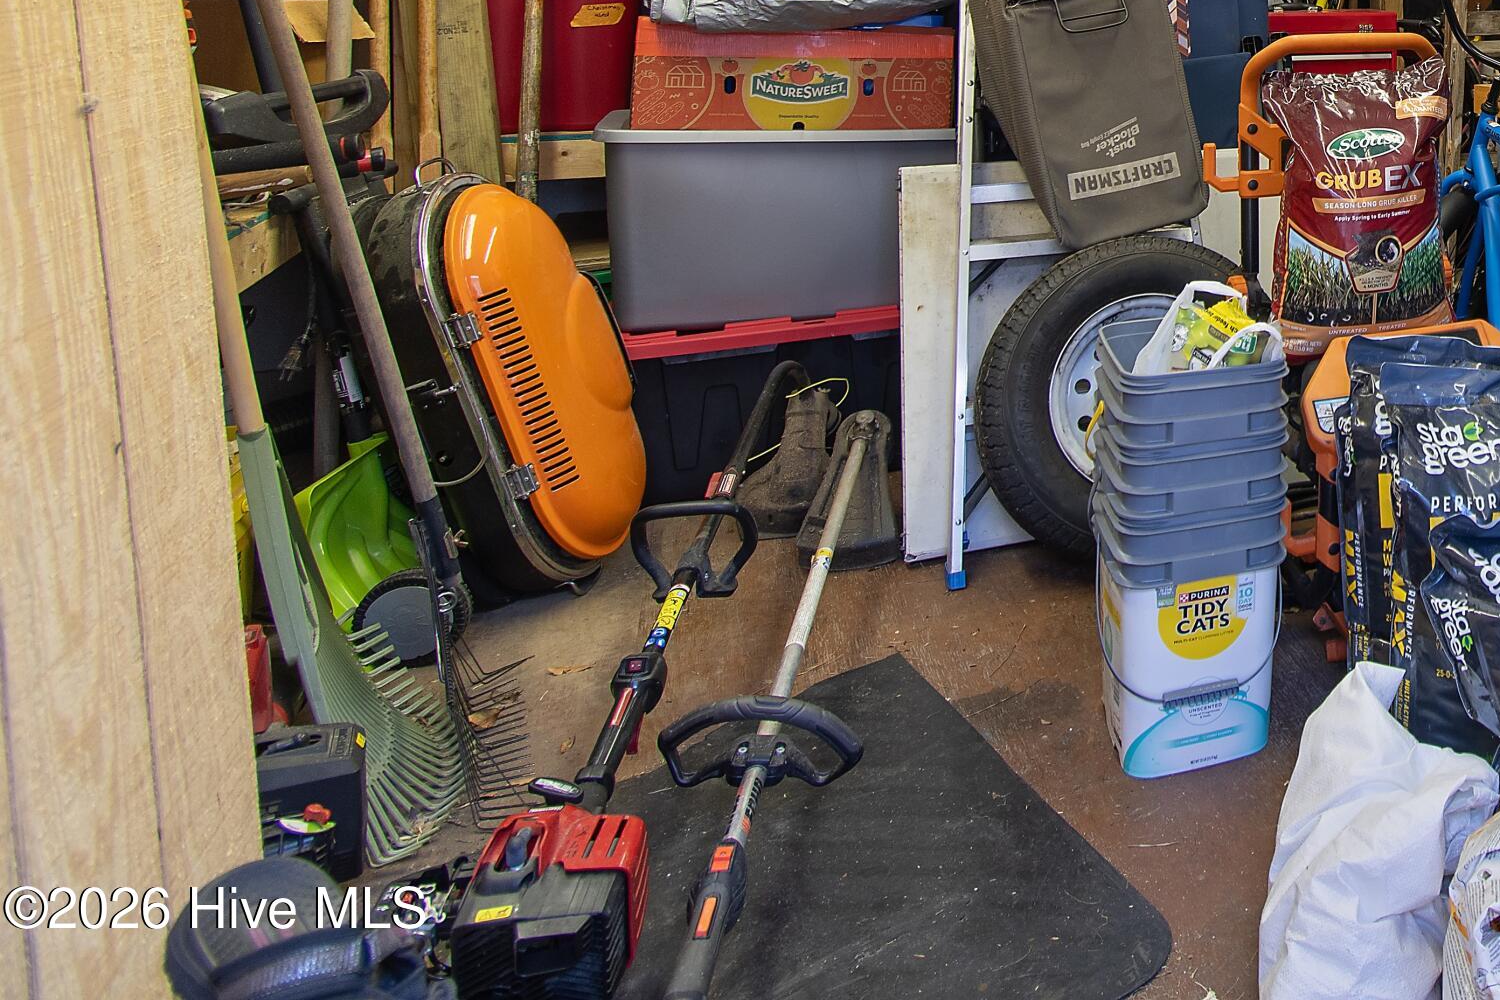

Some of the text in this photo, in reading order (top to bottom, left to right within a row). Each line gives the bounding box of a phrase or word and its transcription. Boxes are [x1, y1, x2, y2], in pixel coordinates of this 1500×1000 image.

[1080, 141, 1091, 149] Bag
[1095, 124, 1141, 153] Blocker
[1105, 137, 1137, 158] Dust-
[1074, 159, 1175, 194] CRAFTSMAN
[1324, 202, 1355, 210] SEASON
[1357, 200, 1377, 209] LONG
[1334, 209, 1411, 223] Apply Spring to Early Summer
[1367, 281, 1390, 290] MONTHS
[1328, 322, 1407, 336] UNTREATED TREATED
[1416, 421, 1465, 448] sta
[1345, 529, 1359, 606] MAX
[1354, 532, 1364, 609] PERFORMANCE
[1190, 587, 1229, 601] PURINA
[1238, 587, 1253, 600] 10
[1178, 598, 1229, 619] TIDY
[1391, 569, 1407, 657] MAX
[1176, 613, 1230, 635] CATS
[1188, 702, 1223, 713] UNSCENTED
[1404, 679, 1412, 729] MULTI-ACTIO
